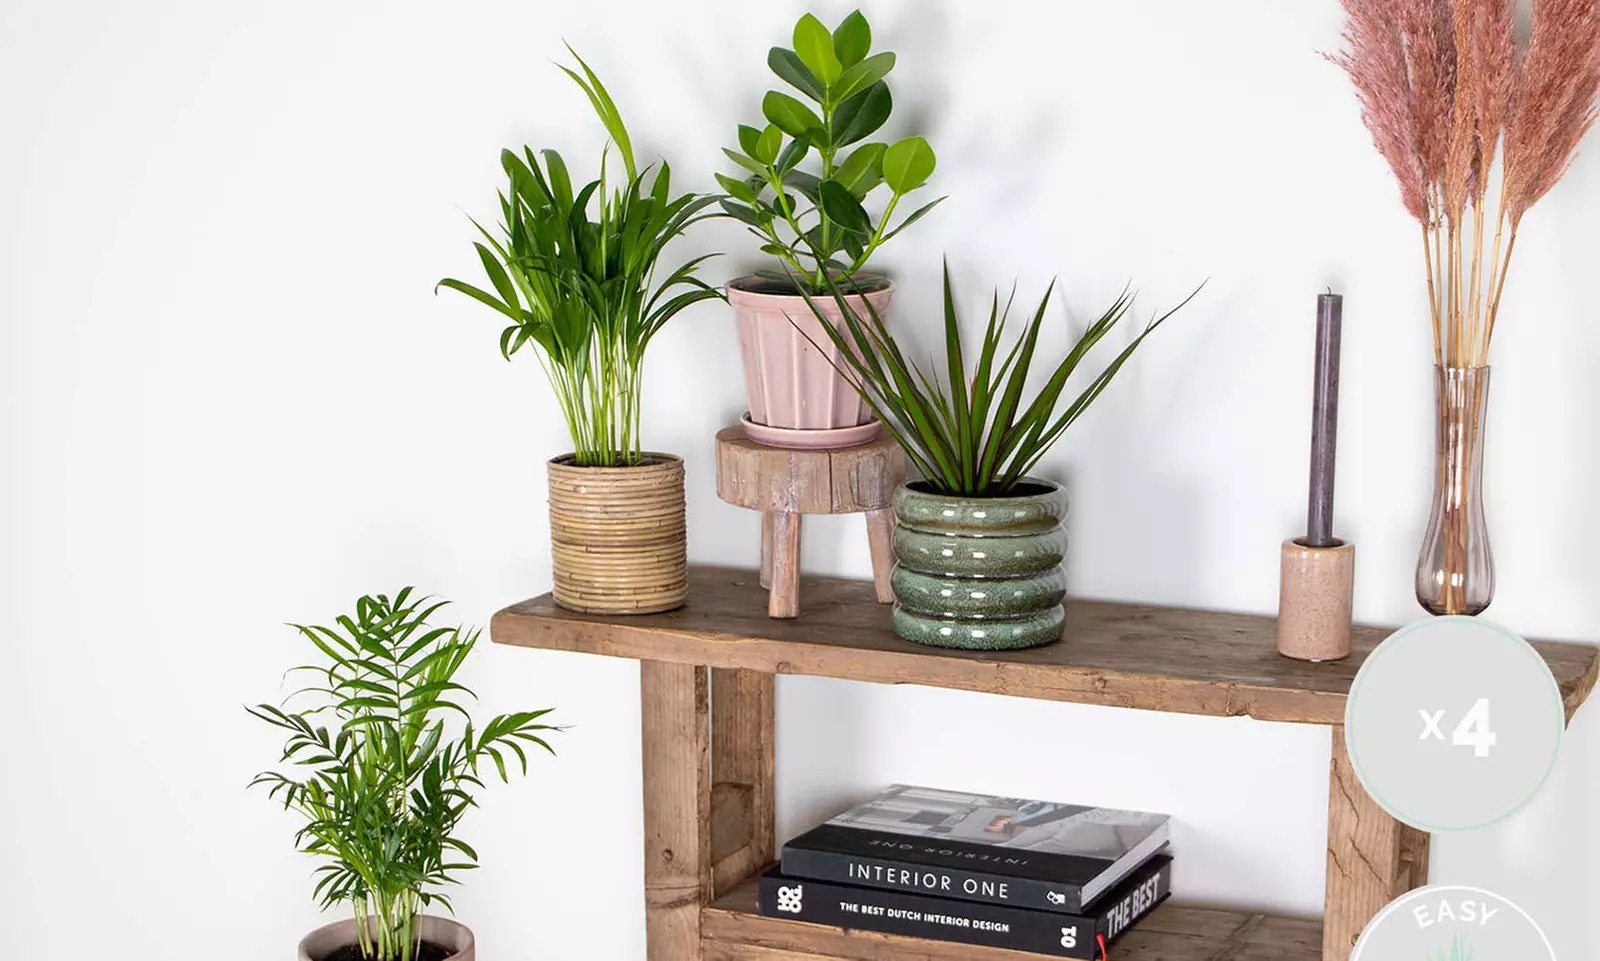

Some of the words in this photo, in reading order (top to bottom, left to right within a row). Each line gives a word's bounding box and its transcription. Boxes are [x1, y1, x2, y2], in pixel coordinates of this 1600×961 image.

[868, 839, 914, 850] ONE
[924, 847, 1029, 866] INTERIOR
[848, 862, 951, 891] INTERIOR
[963, 878, 1009, 899] ONE
[840, 901, 859, 913] THE
[861, 904, 885, 916] BEST
[887, 908, 921, 921] DUTCH
[923, 913, 970, 928] INTERIOR
[972, 919, 1010, 933] DESIGN
[1106, 895, 1132, 940] THE
[1131, 873, 1160, 920] BEST
[1060, 925, 1077, 949] 01
